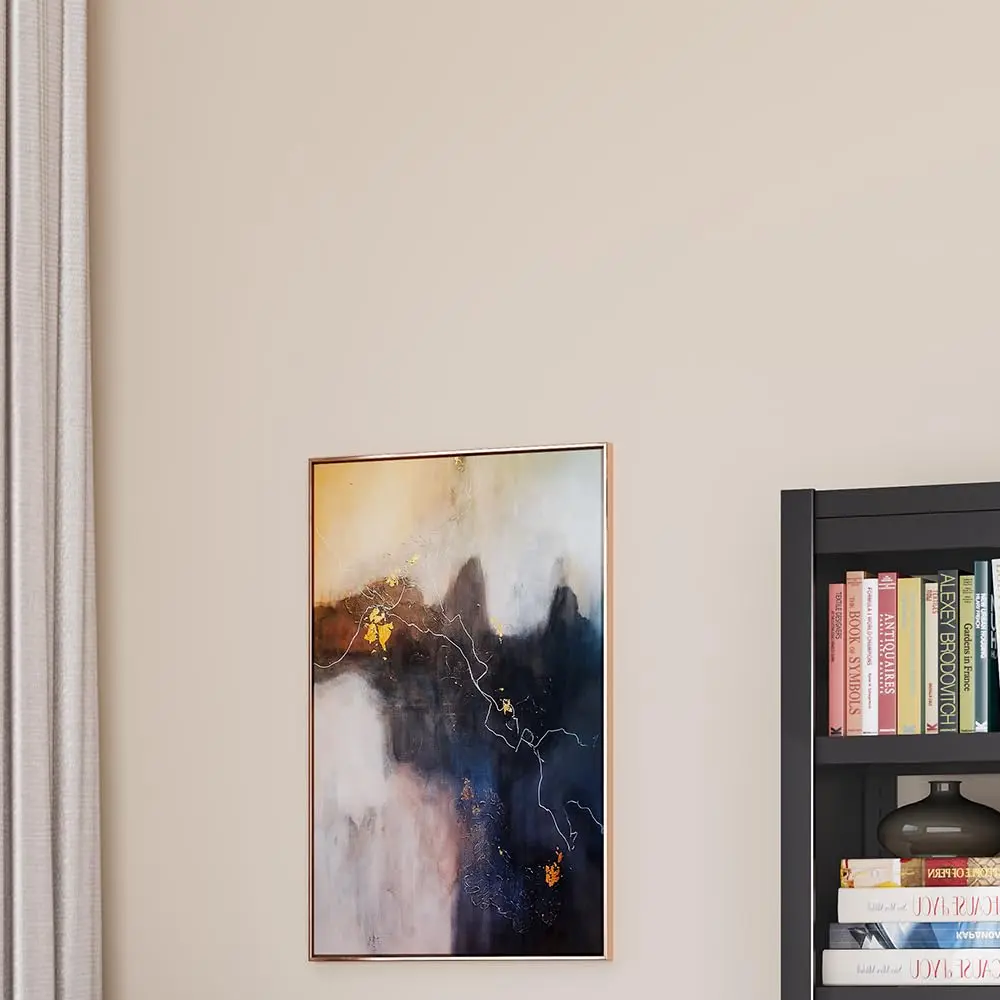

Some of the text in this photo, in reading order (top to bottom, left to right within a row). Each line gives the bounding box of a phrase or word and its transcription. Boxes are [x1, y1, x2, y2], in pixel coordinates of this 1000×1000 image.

[849, 611, 862, 715] BOOK SYMBOLS
[883, 614, 894, 694] ANTIQUAIRES
[940, 574, 955, 724] ALEXEY BRODOVITCH
[963, 623, 972, 654] Gardens
[964, 666, 972, 691] France
